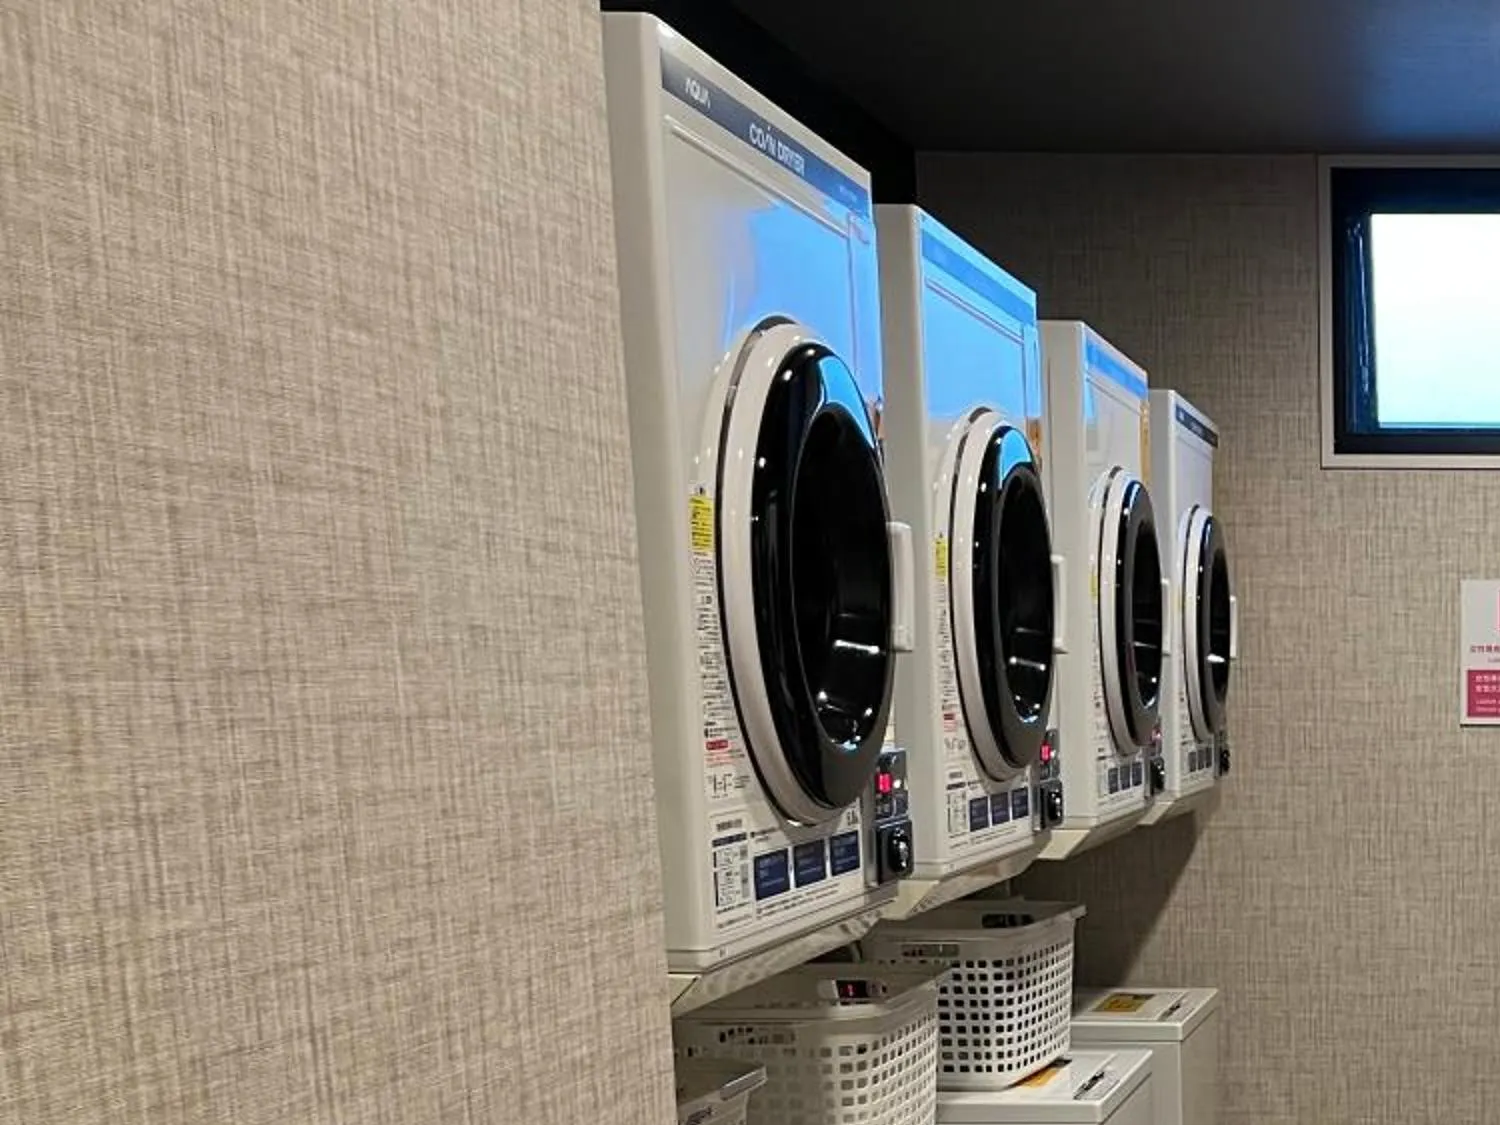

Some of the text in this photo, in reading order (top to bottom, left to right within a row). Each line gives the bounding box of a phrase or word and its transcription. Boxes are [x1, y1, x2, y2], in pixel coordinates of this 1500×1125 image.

[685, 78, 711, 109] AQUA
[749, 122, 806, 176] COIN DRYER
